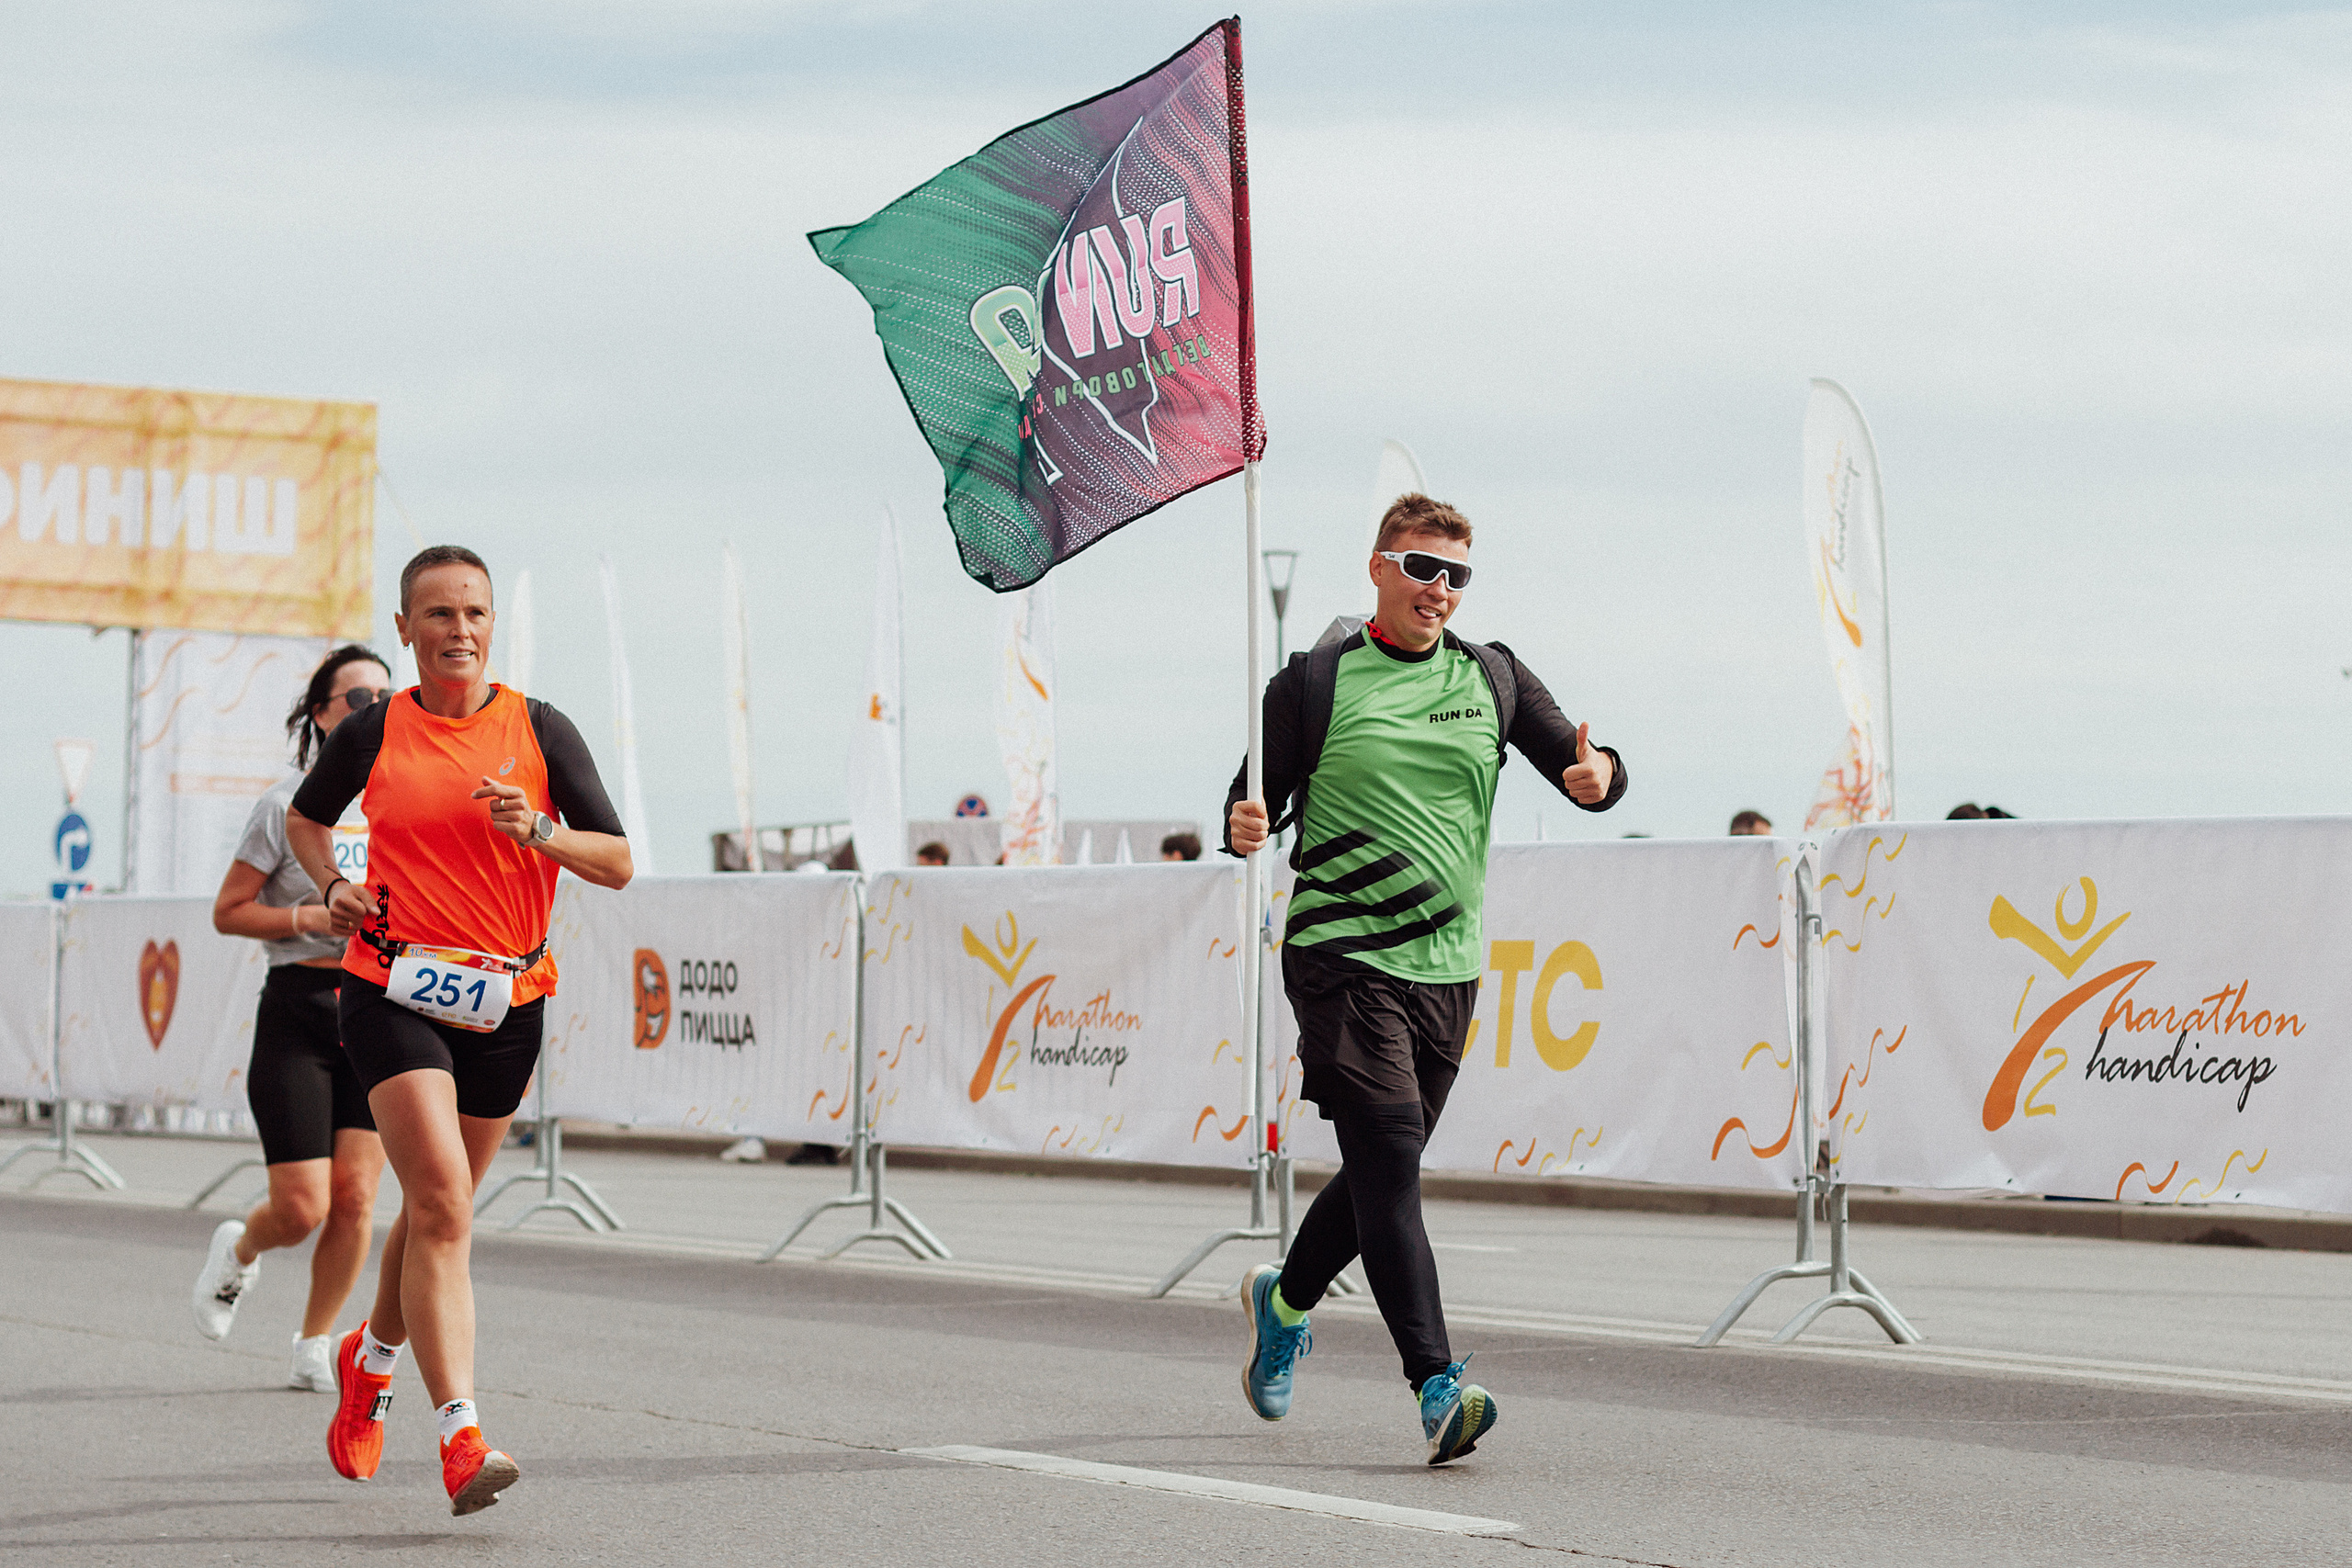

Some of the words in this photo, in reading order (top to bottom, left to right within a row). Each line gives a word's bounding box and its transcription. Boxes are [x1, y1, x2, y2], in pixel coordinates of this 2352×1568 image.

[0, 459, 298, 556] ИНИШ
[1430, 709, 1460, 724] RUN
[1465, 708, 1483, 718] DA
[410, 967, 487, 1012] 251
[679, 960, 738, 999] ДОДО
[681, 1010, 756, 1053] ПИЦЦА
[1030, 1025, 1129, 1088] handicap
[2086, 1026, 2277, 1113] handicap
